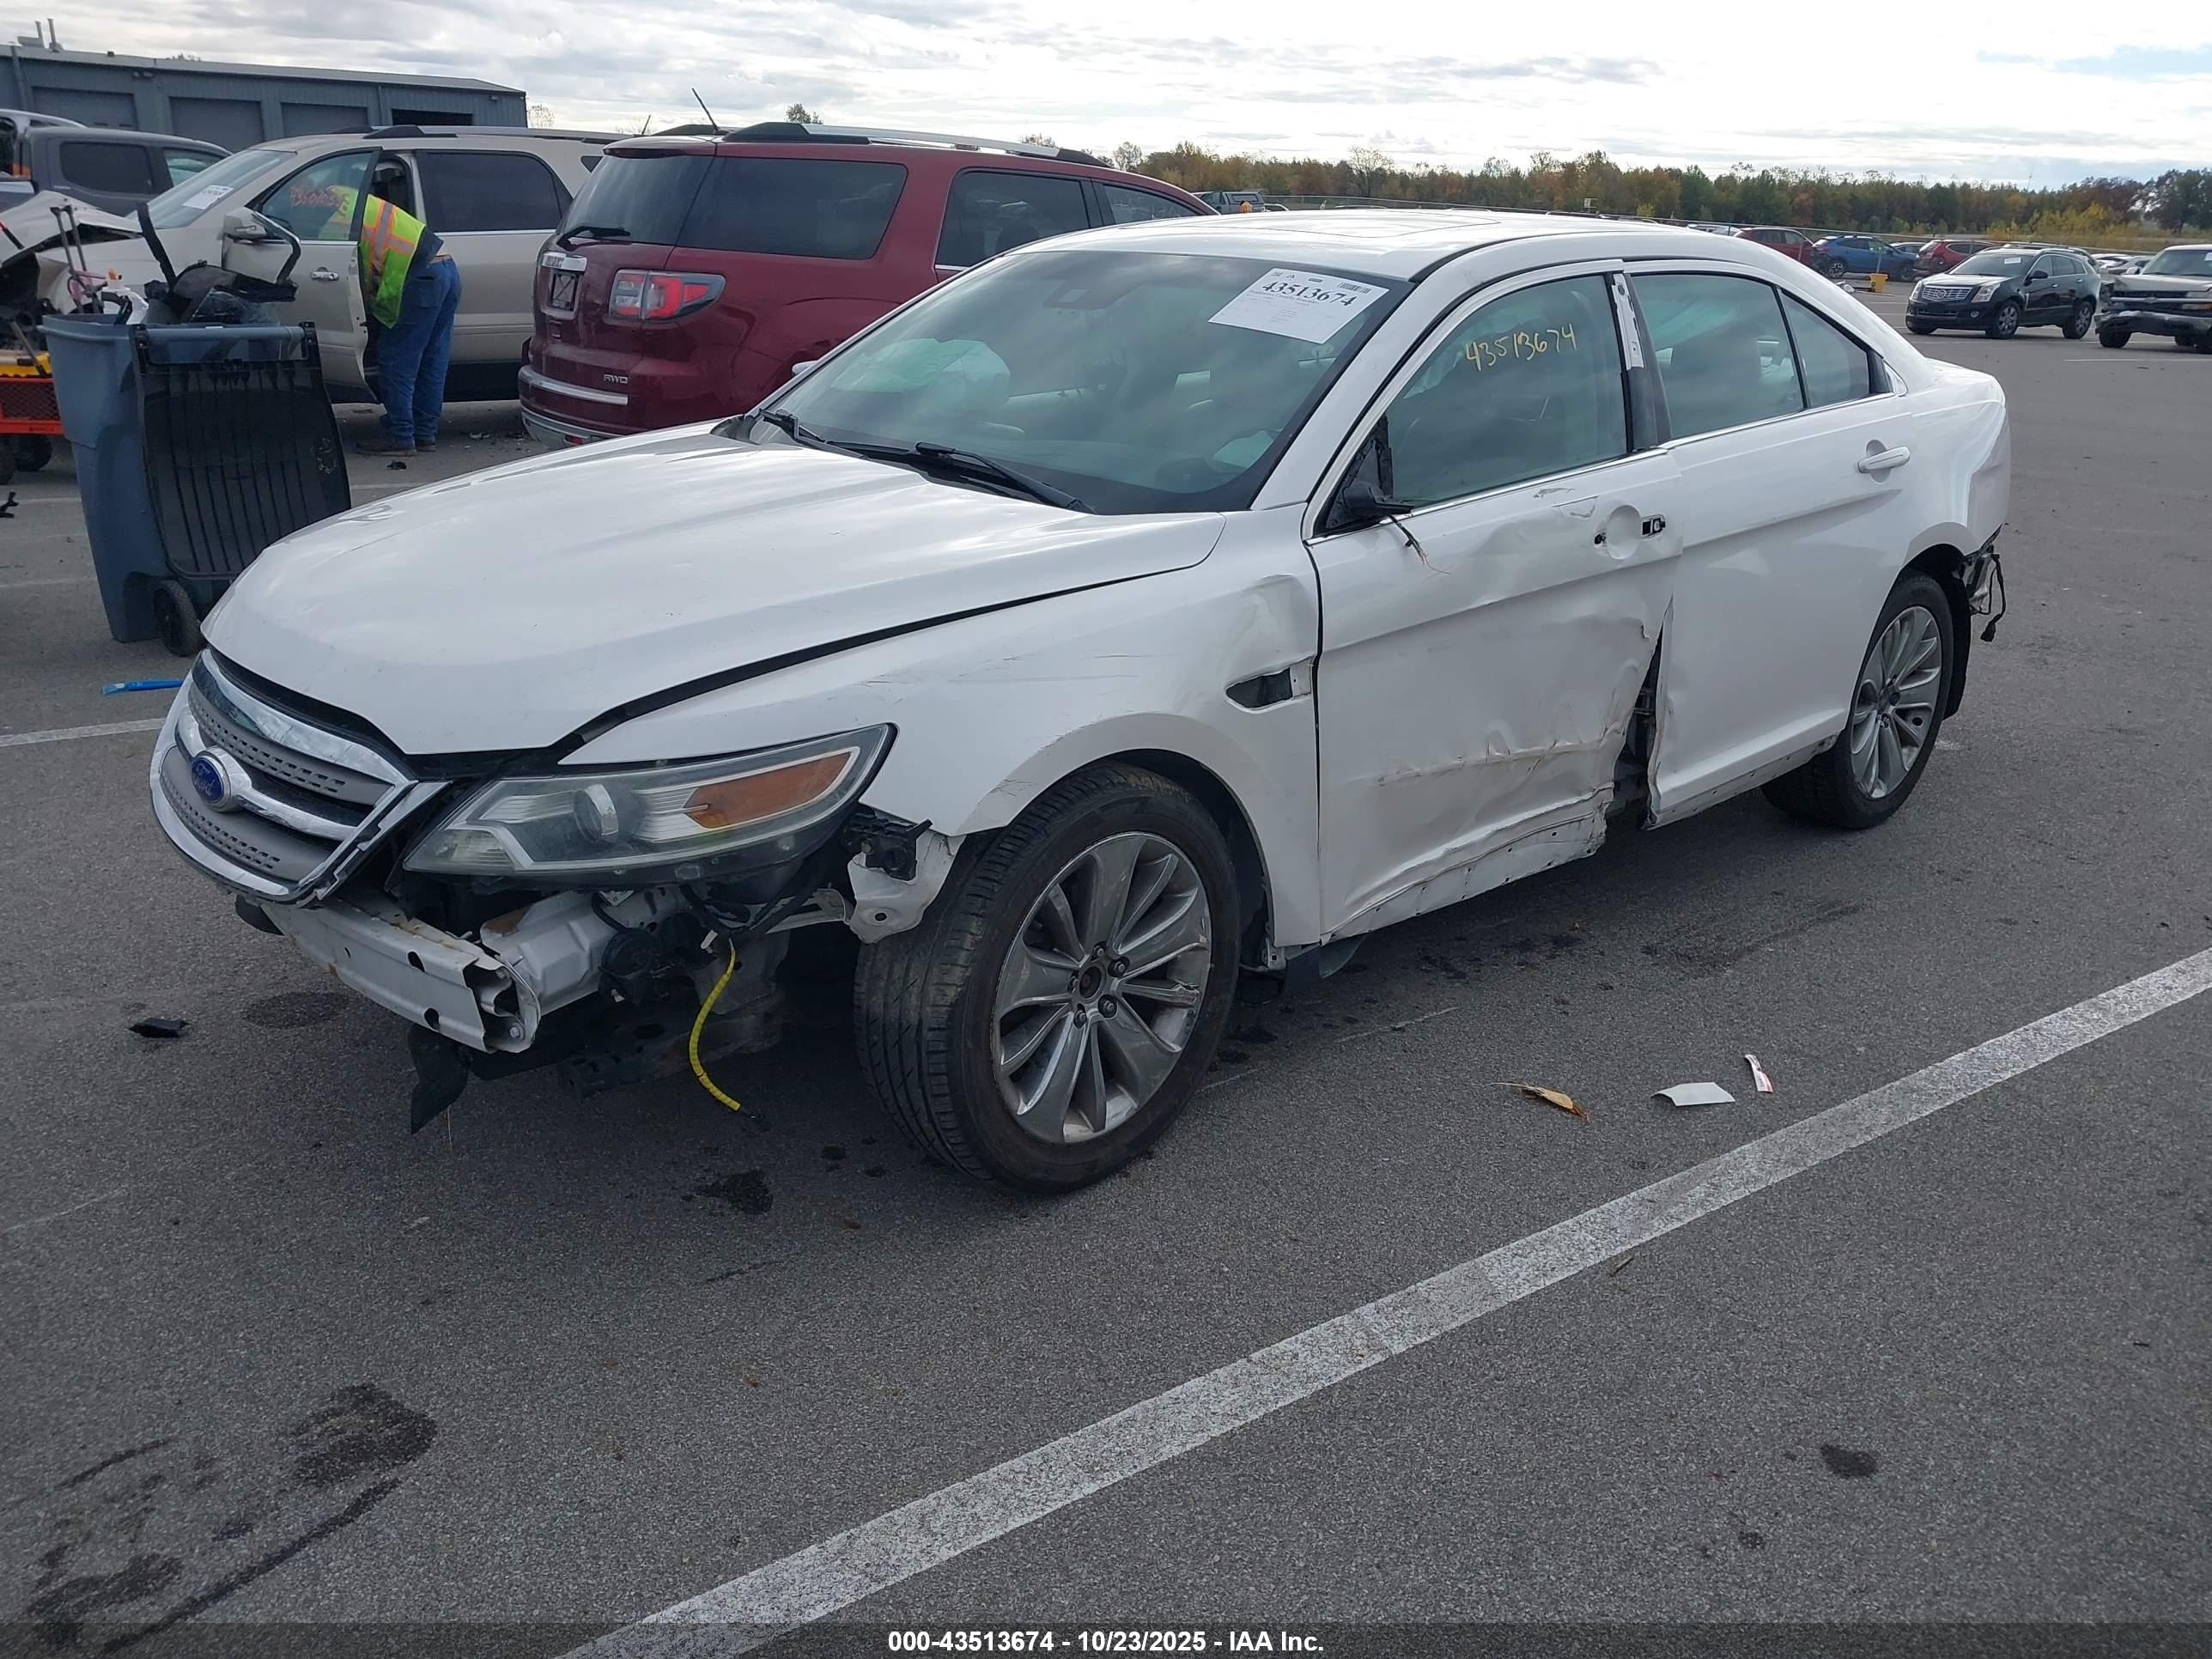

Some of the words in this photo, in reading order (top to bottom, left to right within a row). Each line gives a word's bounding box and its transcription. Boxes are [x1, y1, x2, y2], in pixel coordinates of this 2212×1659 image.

[1262, 281, 1358, 307] 43513674
[1465, 323, 1577, 371] 43513674
[604, 374, 629, 384] AWD
[194, 763, 216, 796] Ford
